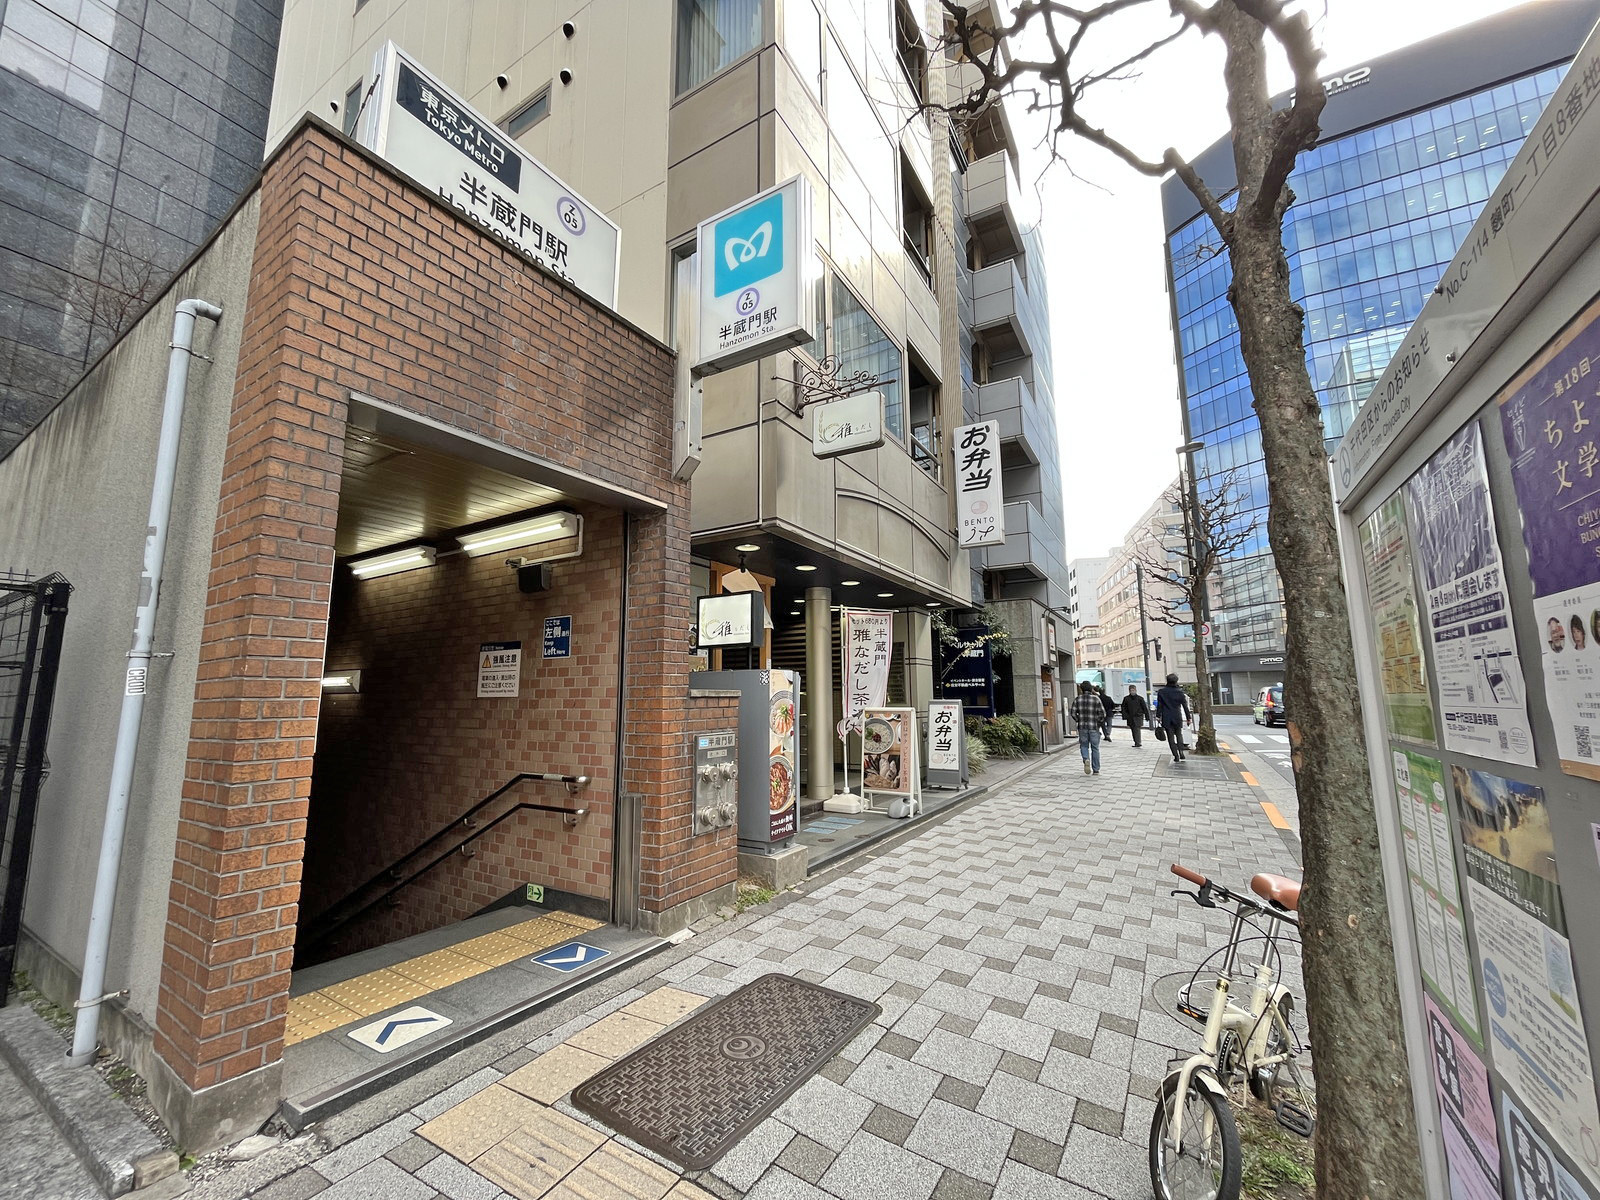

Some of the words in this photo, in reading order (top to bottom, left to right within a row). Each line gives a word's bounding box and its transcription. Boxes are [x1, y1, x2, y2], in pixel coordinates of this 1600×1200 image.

[419, 86, 505, 164] 東京メトロ
[425, 108, 462, 145] Tokyo
[464, 139, 499, 173] Metro
[459, 171, 568, 268] 半蔵門駅
[564, 213, 578, 229] 05
[569, 204, 576, 216] Z
[742, 300, 754, 311] 05
[745, 292, 751, 301] Z
[719, 306, 777, 340] 半蔵門駅
[719, 330, 759, 350] Hanzomon
[761, 325, 776, 335] Sta.
[1553, 356, 1592, 398] 第18回
[1544, 380, 1600, 449] ちよ
[960, 425, 993, 492] お弁当
[964, 516, 995, 527] BENTO
[1577, 508, 1600, 527] CHIY
[1580, 528, 1600, 544] BUN
[544, 646, 557, 656] Left
[873, 628, 888, 666] 半蔵門
[708, 736, 734, 747] 半蔵門駅
[934, 711, 952, 751] お弁当
